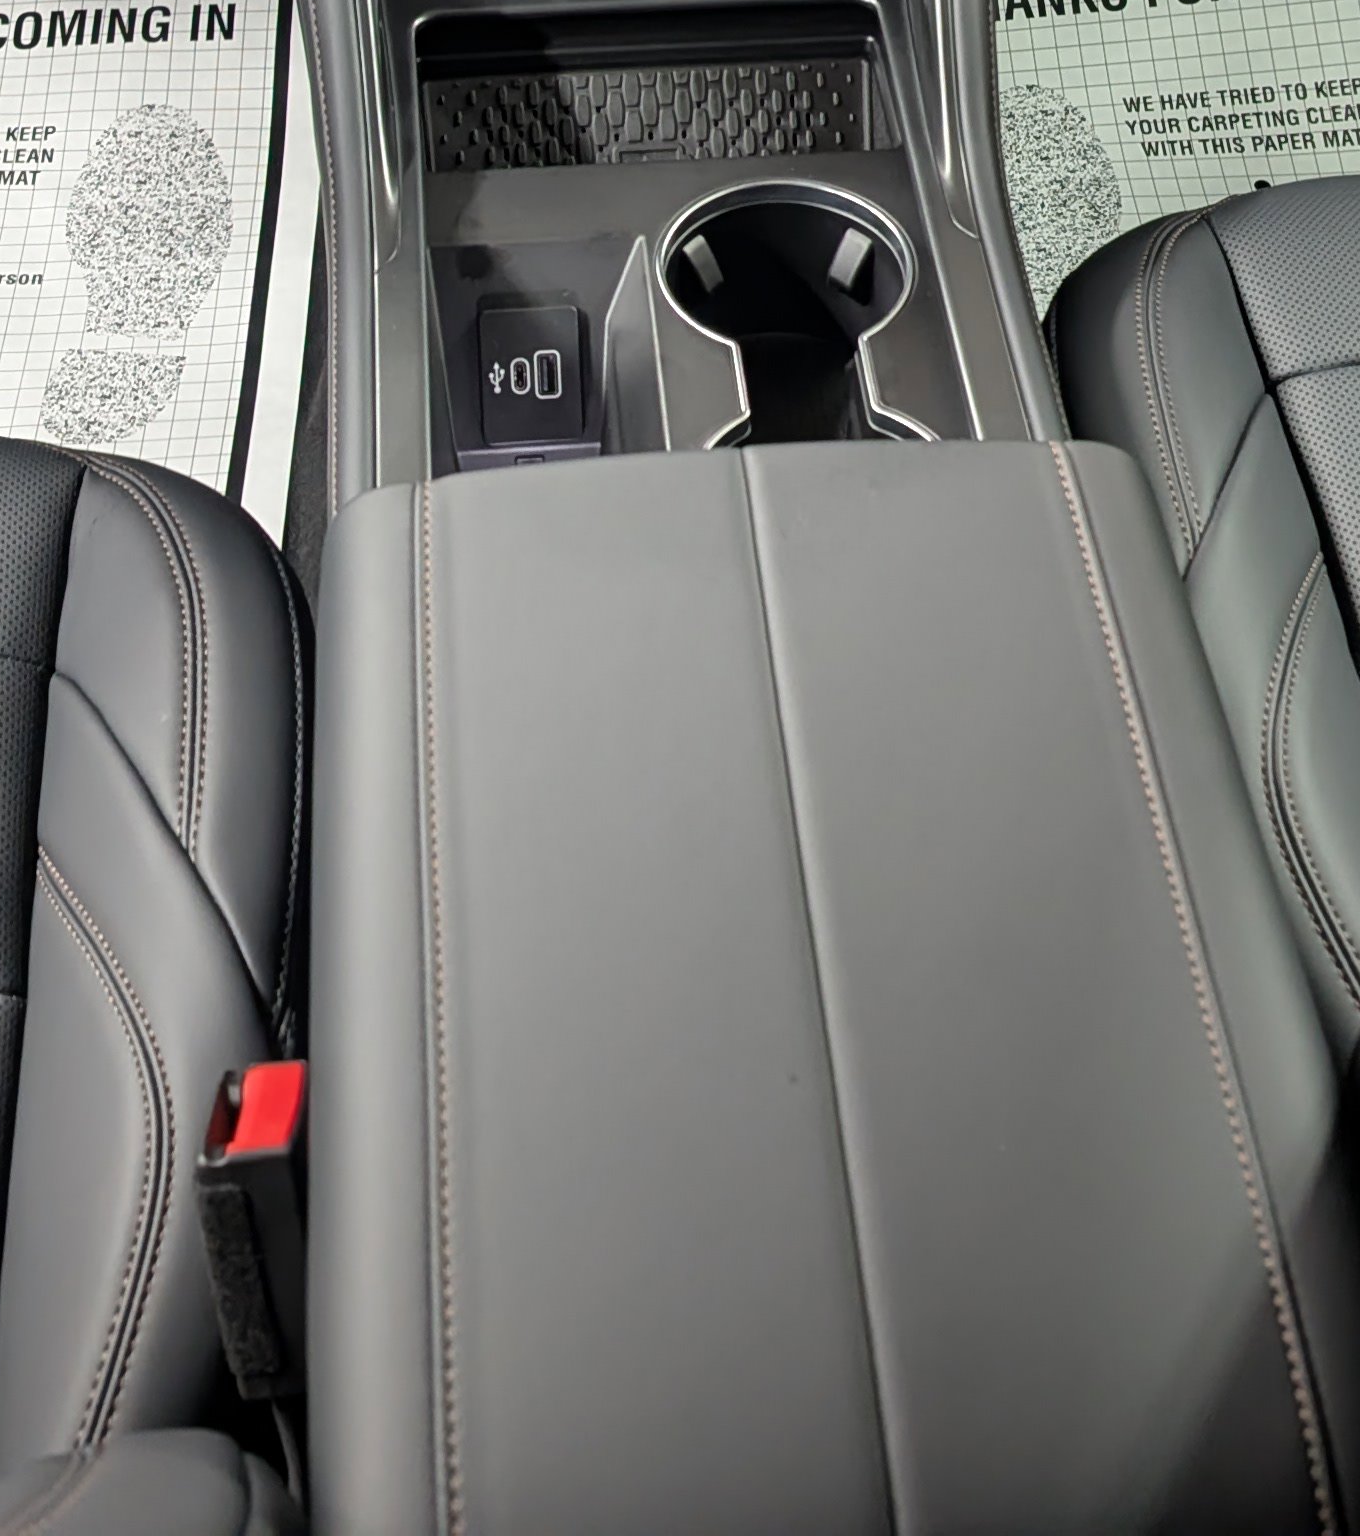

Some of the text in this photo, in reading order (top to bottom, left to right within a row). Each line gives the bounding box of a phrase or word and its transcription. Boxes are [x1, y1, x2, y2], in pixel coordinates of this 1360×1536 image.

[189, 2, 237, 42] IN
[1122, 95, 1154, 114] WE
[1160, 91, 1212, 112] HAVE
[1216, 85, 1275, 108] TRIED
[1283, 83, 1308, 102] TO
[6, 125, 56, 143] KEEP
[1125, 118, 1181, 137] YOUR
[1187, 107, 1300, 132] CARPETING
[1140, 139, 1194, 158] WITH
[1197, 135, 1245, 155] THIS
[1252, 131, 1317, 153] PAPER
